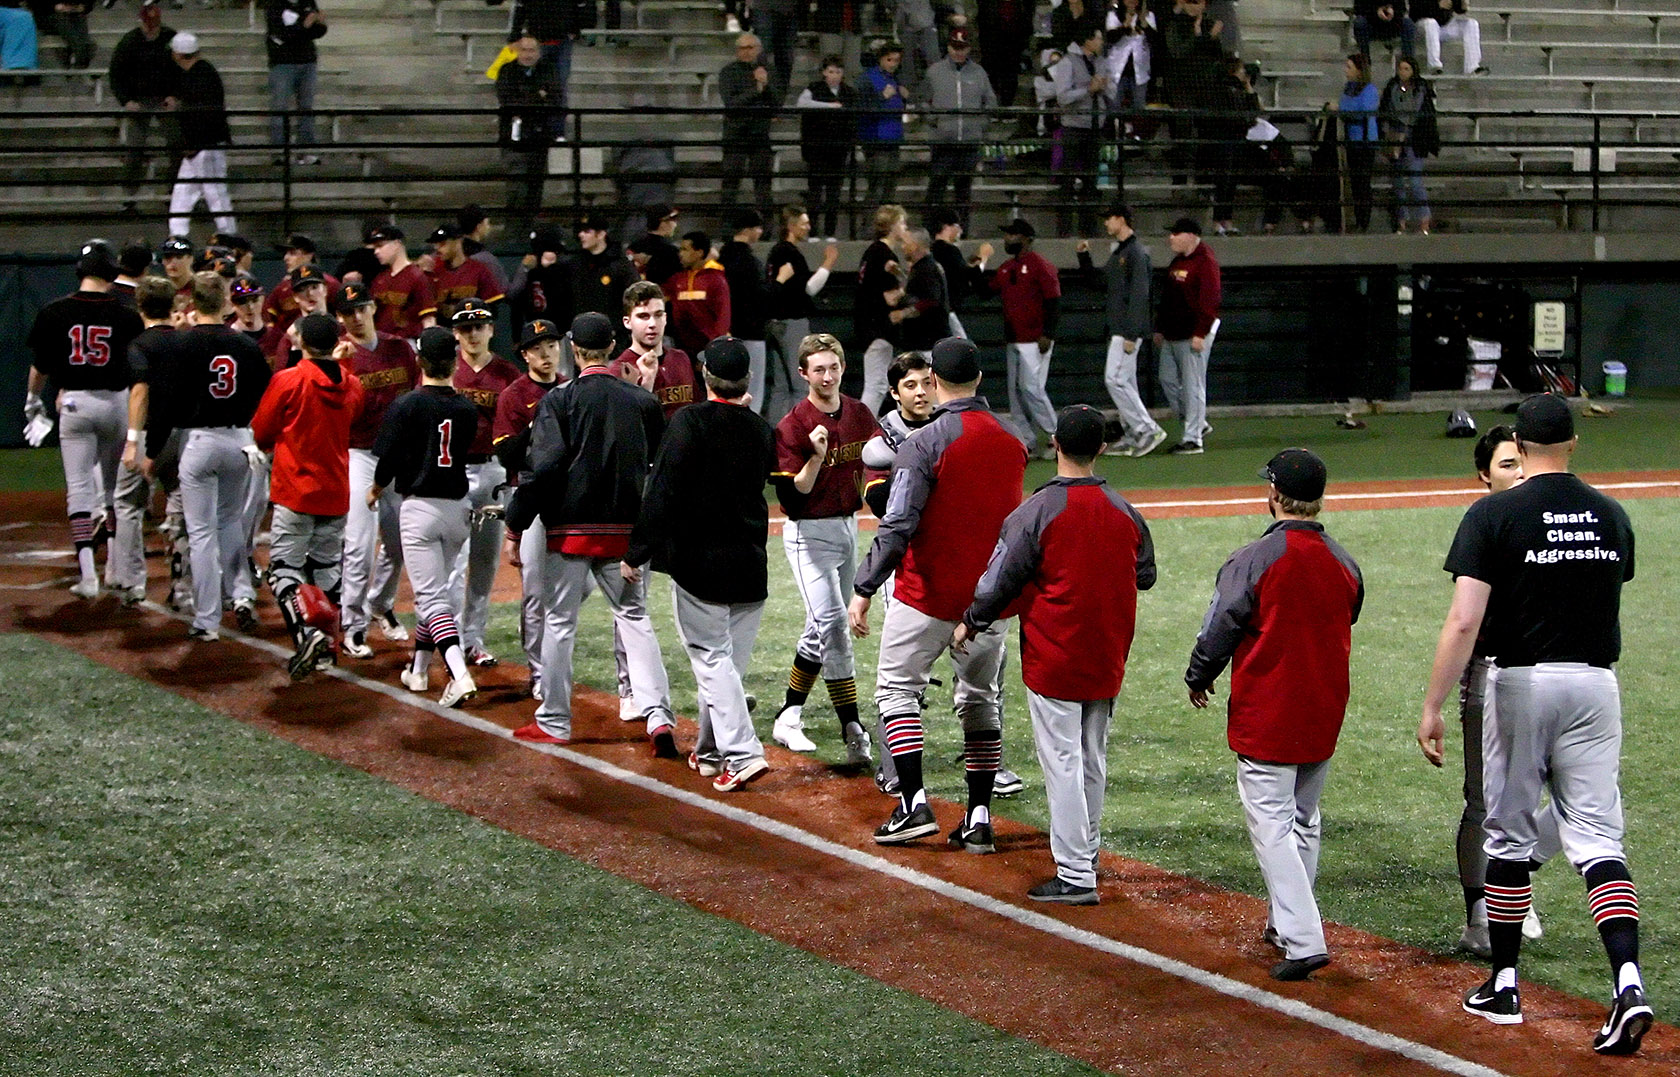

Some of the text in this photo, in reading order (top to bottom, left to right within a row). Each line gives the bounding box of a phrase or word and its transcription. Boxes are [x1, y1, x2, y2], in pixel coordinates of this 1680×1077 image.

[345, 286, 358, 300] L
[533, 321, 546, 335] L
[69, 324, 112, 366] 15
[209, 355, 237, 399] 3
[438, 419, 453, 467] 1
[1542, 510, 1599, 524] Smart.
[1546, 529, 1601, 542] Clean.
